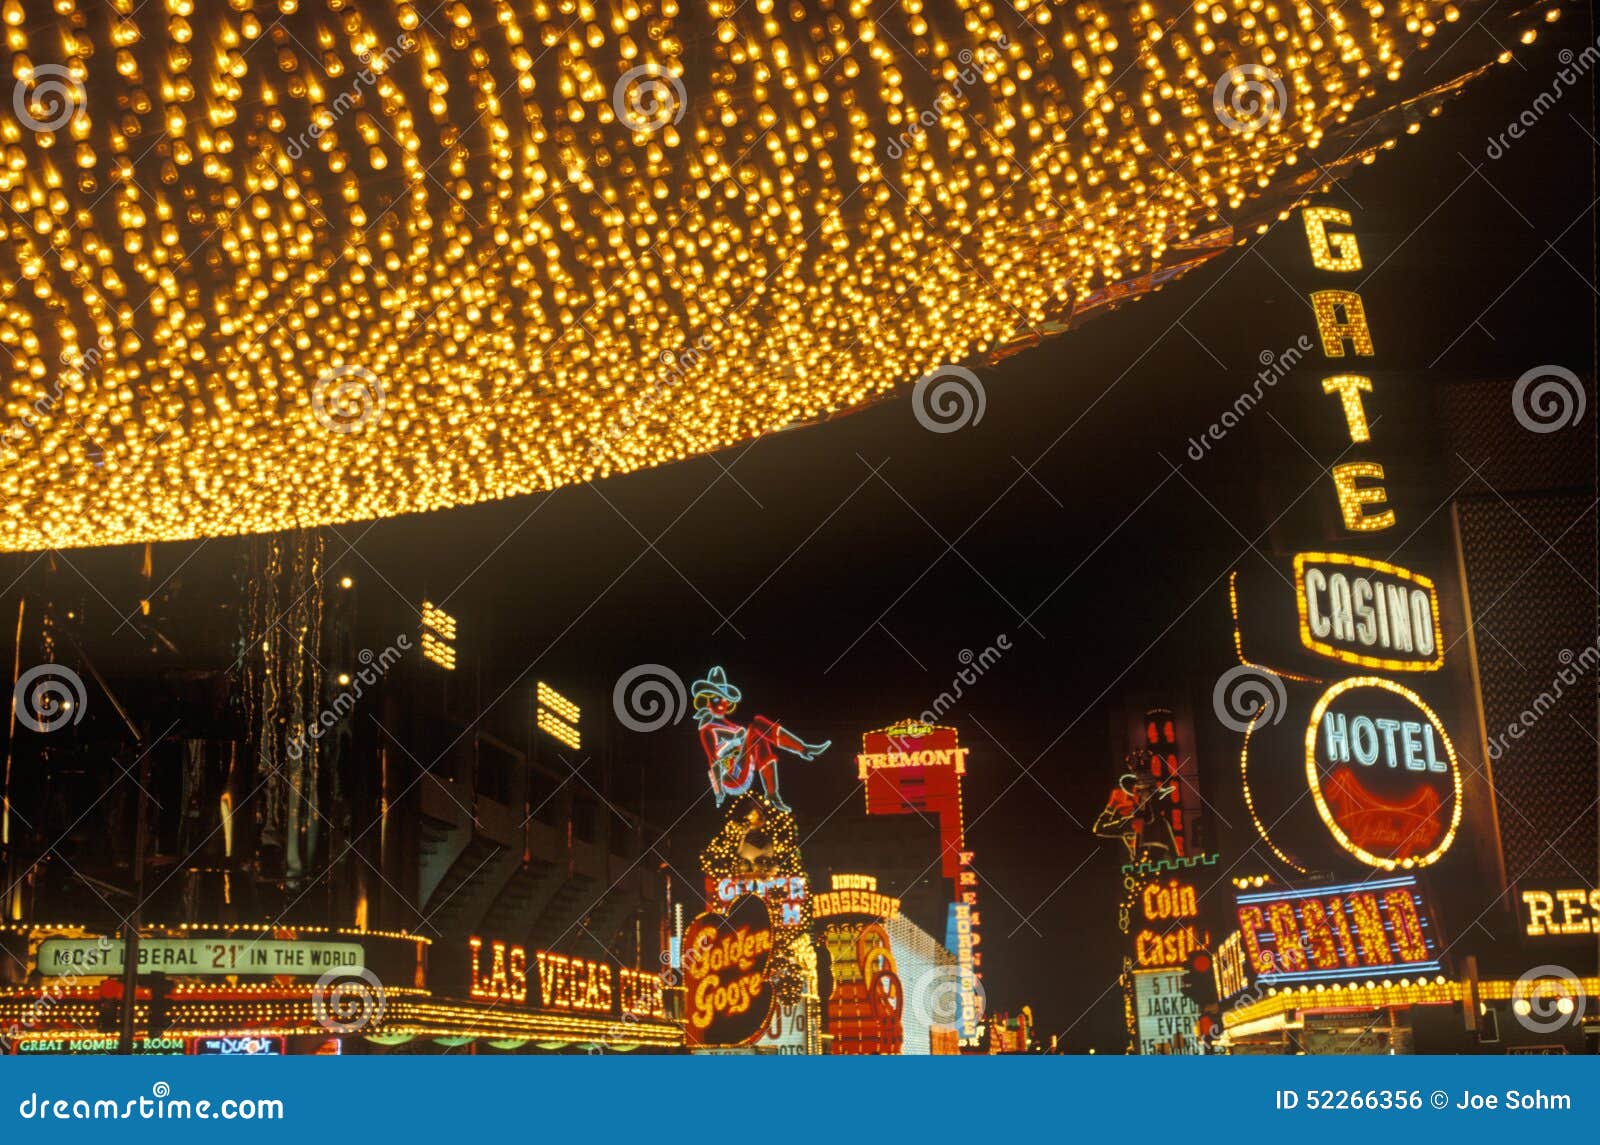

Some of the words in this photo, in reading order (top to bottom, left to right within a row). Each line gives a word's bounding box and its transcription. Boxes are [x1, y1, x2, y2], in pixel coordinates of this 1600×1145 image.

[1302, 206, 1396, 532] GATE
[1304, 567, 1435, 656] CASINO
[857, 748, 969, 780] FREMONT
[1324, 711, 1448, 774] HOTEL
[1143, 880, 1198, 921] Coin
[54, 947, 111, 966] MOST
[120, 946, 198, 966] LBERAL
[250, 948, 268, 966] IN
[275, 948, 304, 966] THE
[310, 949, 357, 967] WORLD
[690, 926, 771, 979] Golden
[1237, 889, 1428, 975] CASINO
[470, 936, 527, 1000] LAS
[536, 950, 612, 1012] VEGAS
[693, 970, 764, 1028] Goose
[1147, 995, 1199, 1017] JACKPO
[20, 1039, 62, 1050] GREAT
[143, 1038, 184, 1050] ROOM
